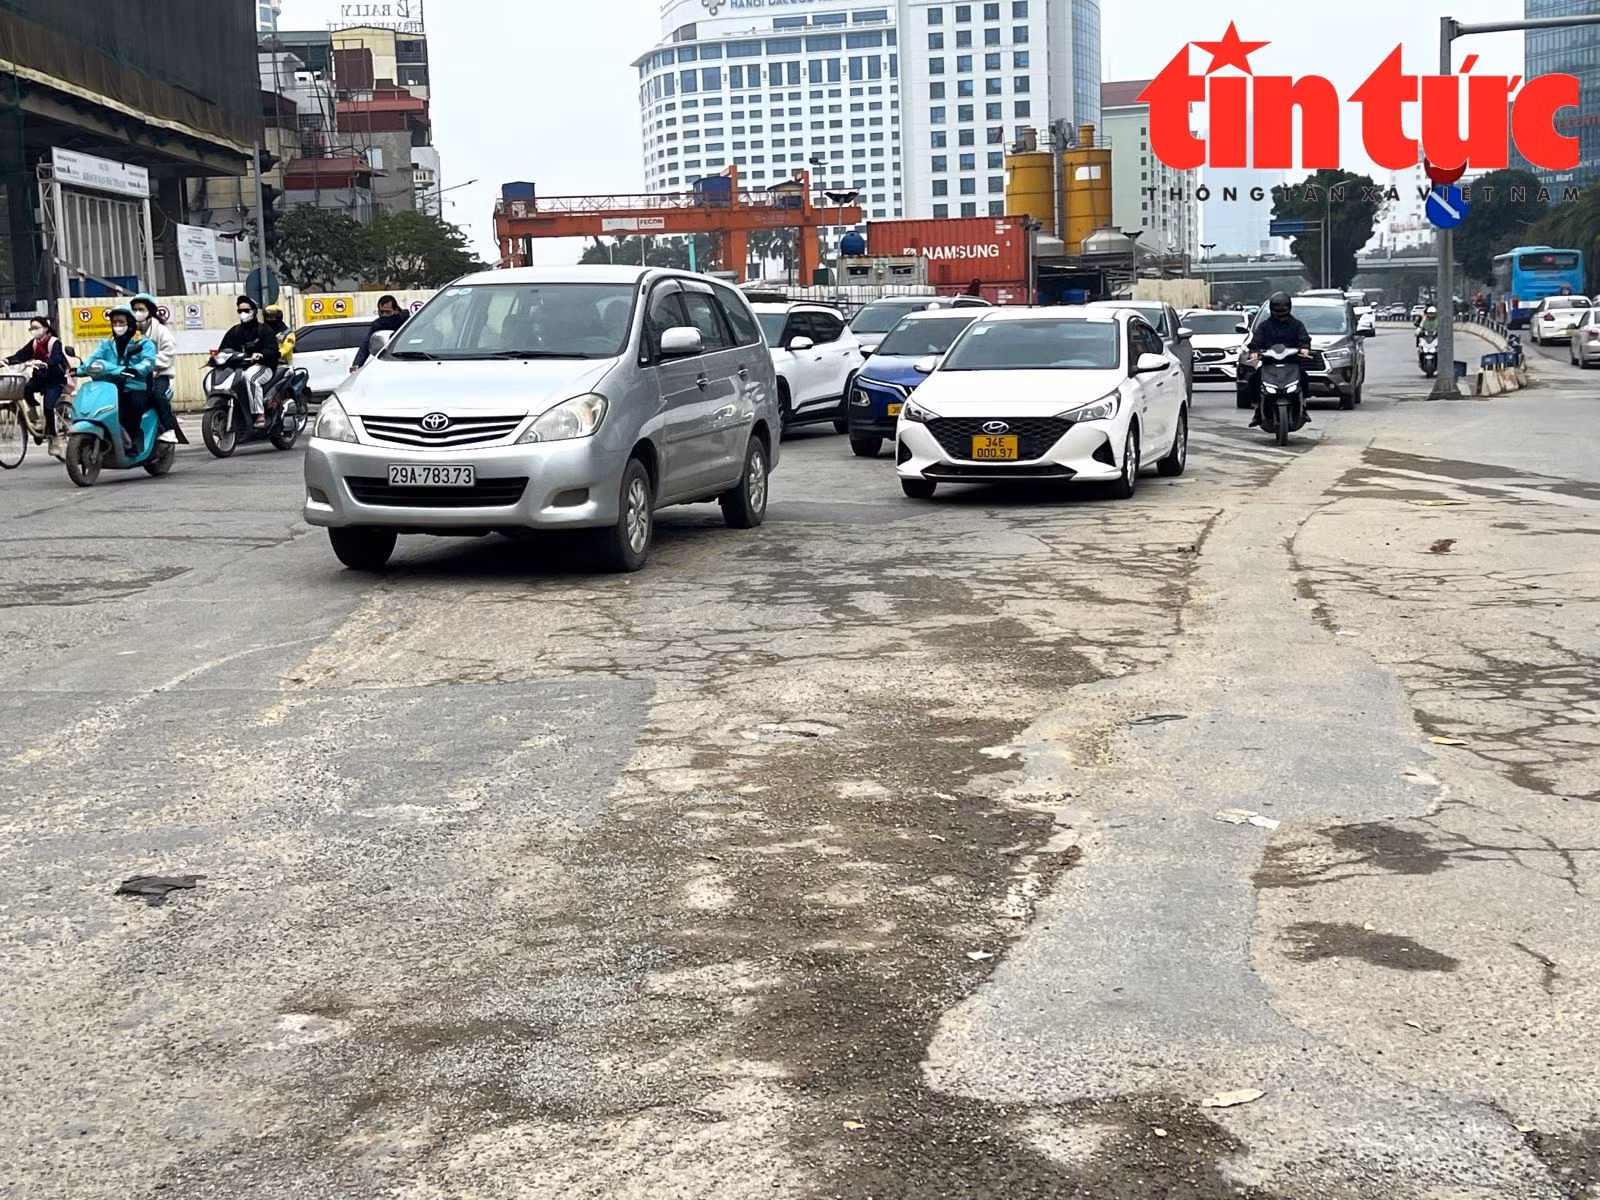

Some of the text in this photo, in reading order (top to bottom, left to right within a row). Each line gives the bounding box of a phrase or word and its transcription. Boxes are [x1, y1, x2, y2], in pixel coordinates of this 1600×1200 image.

[730, 0, 764, 8] HANOI
[922, 244, 1000, 260] NAMSUNG
[985, 437, 1005, 448] 34E
[977, 448, 1013, 458] 000.97
[390, 467, 472, 484] 29A-783.73
